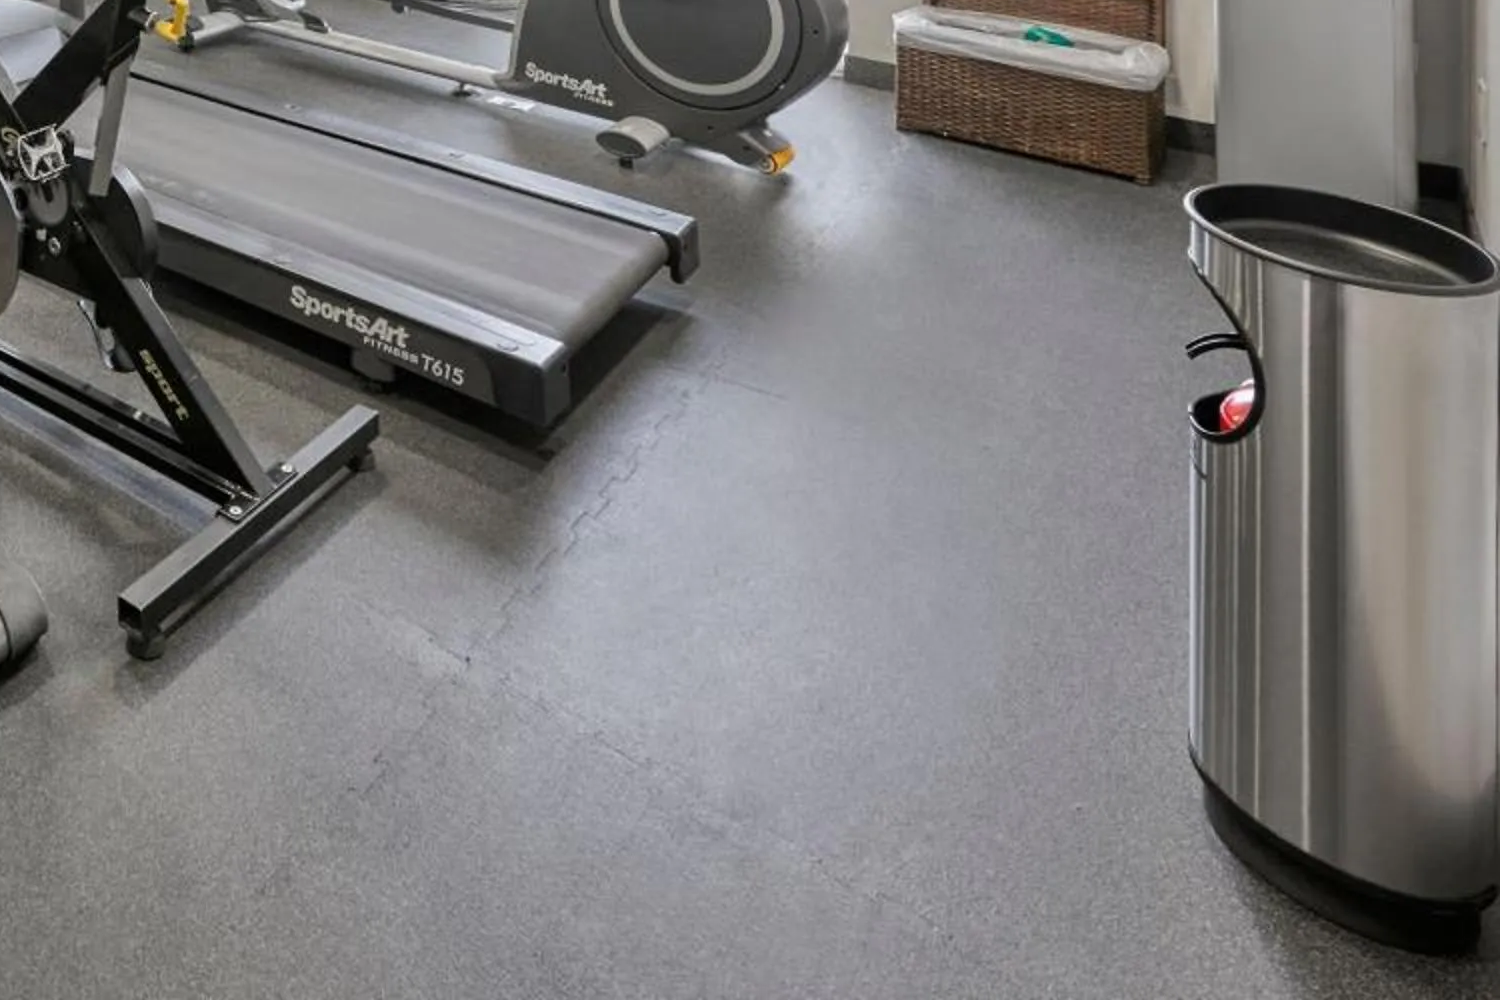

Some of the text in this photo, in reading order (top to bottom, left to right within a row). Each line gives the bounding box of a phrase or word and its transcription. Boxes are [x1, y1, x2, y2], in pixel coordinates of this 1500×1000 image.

[525, 61, 607, 98] SportsArt
[290, 284, 410, 348] SportsArt
[420, 353, 465, 386] T615
